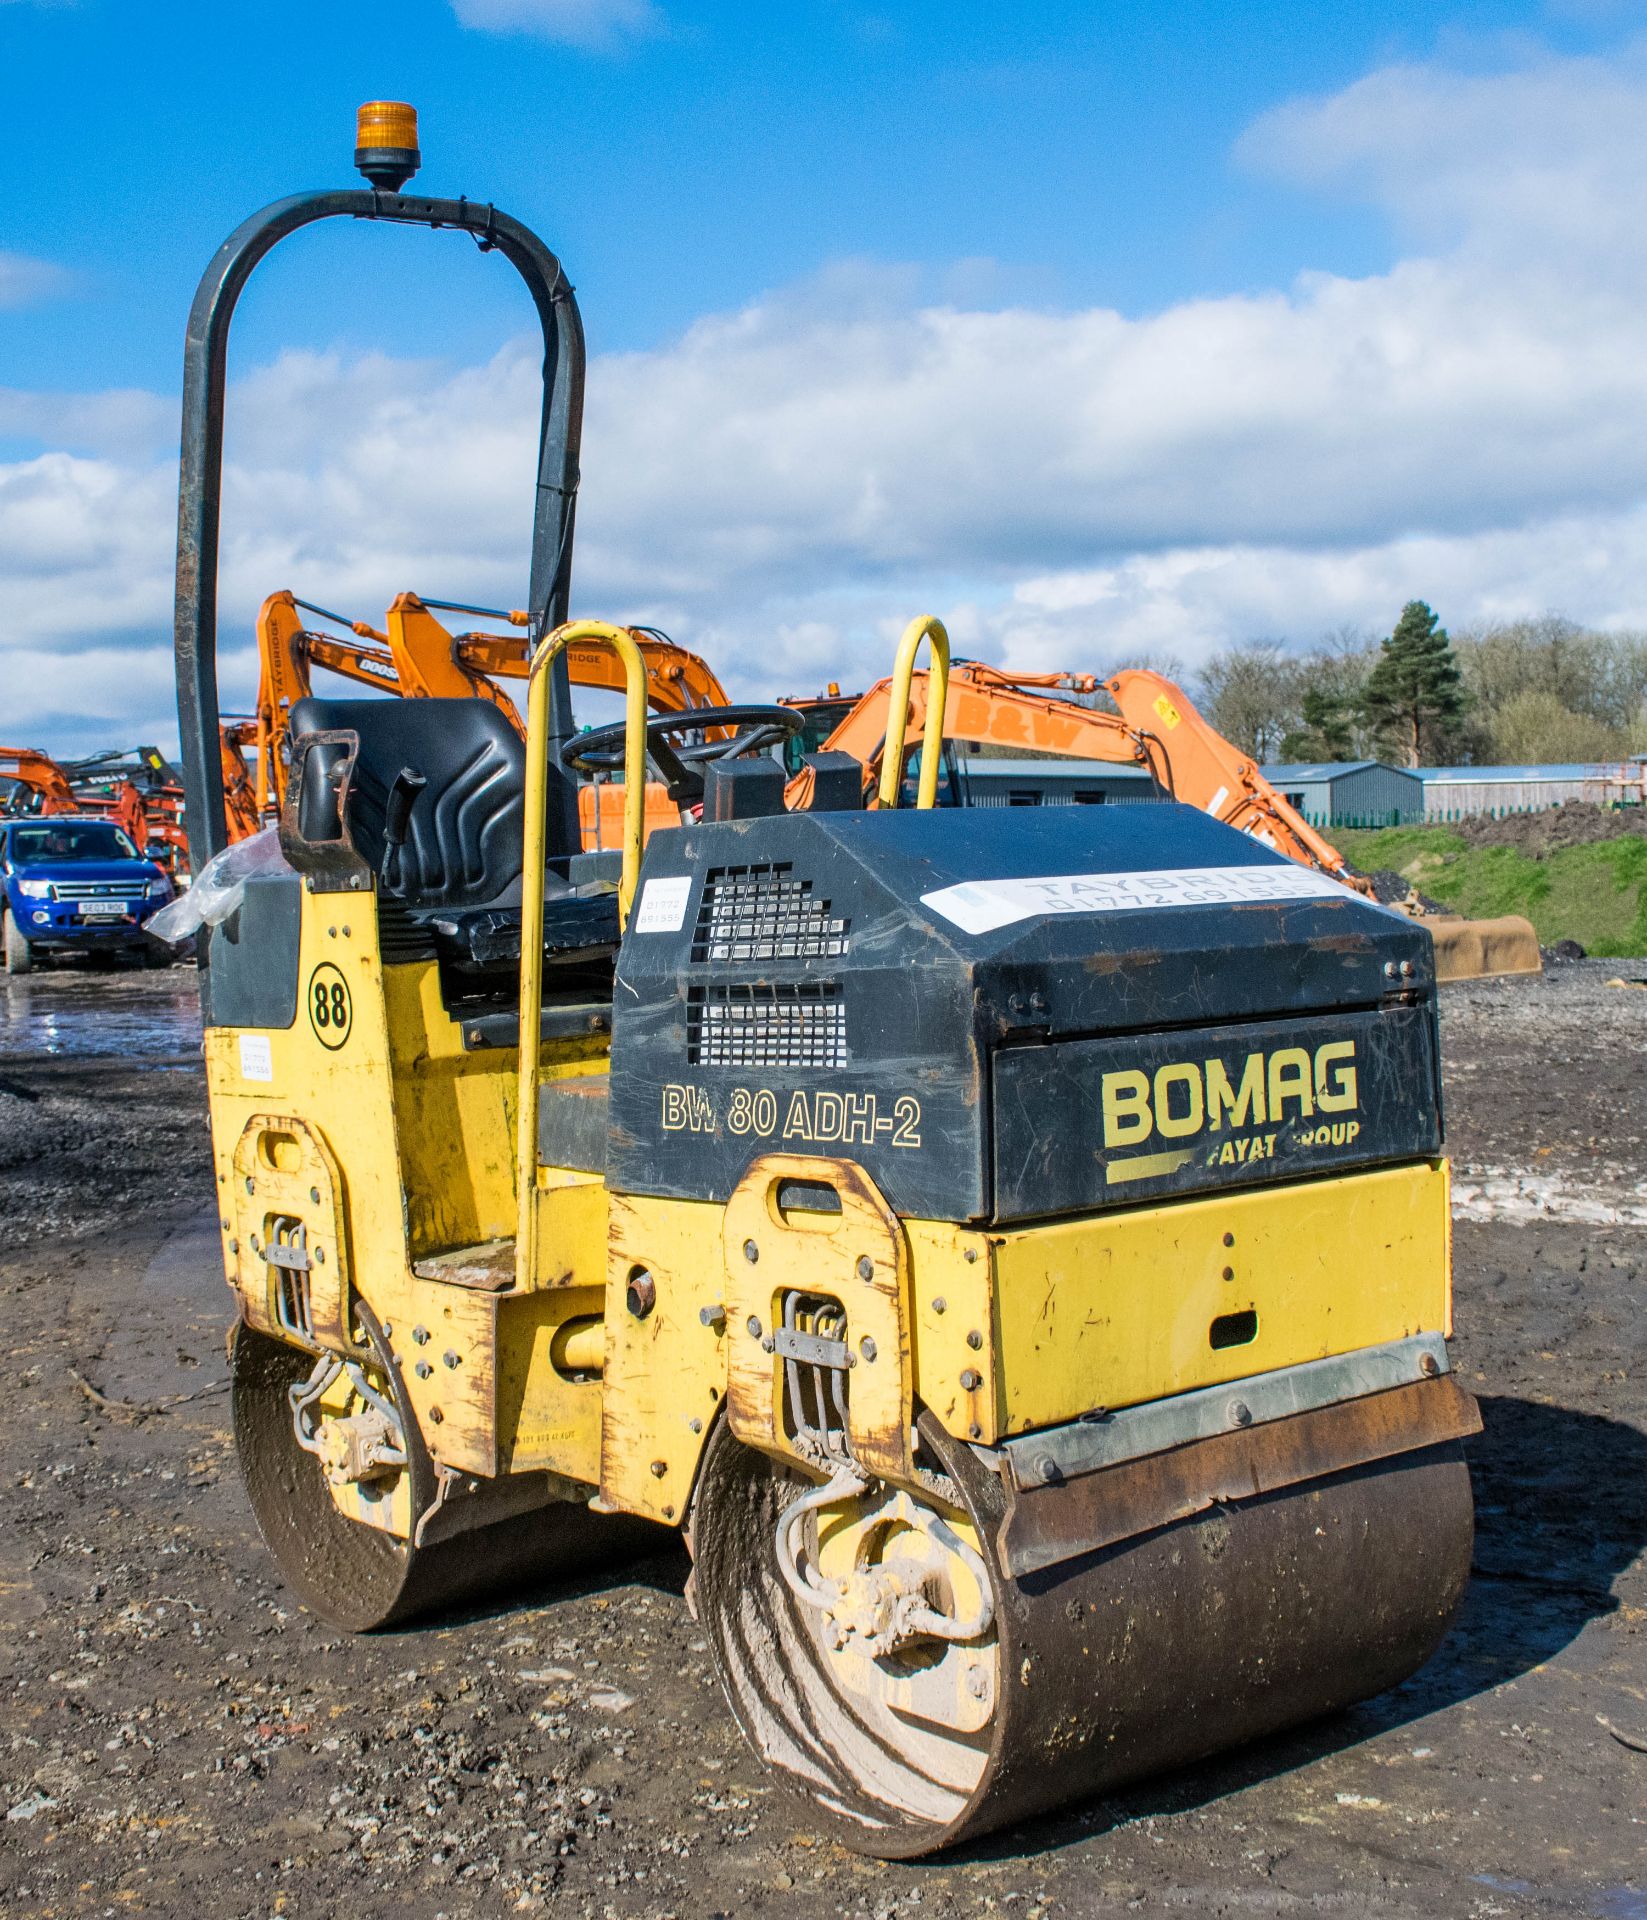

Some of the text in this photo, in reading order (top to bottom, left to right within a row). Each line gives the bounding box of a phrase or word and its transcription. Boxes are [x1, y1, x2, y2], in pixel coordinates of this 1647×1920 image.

[271, 619, 284, 692] TAYBRIDGE
[955, 694, 1084, 749] B&W
[88, 772, 129, 785] VOLVO
[1182, 885, 1317, 902] 691555
[315, 982, 347, 1028] 88
[727, 1088, 778, 1137] 80
[782, 1090, 921, 1148] ADH-2
[1102, 1040, 1358, 1148] BOMAG
